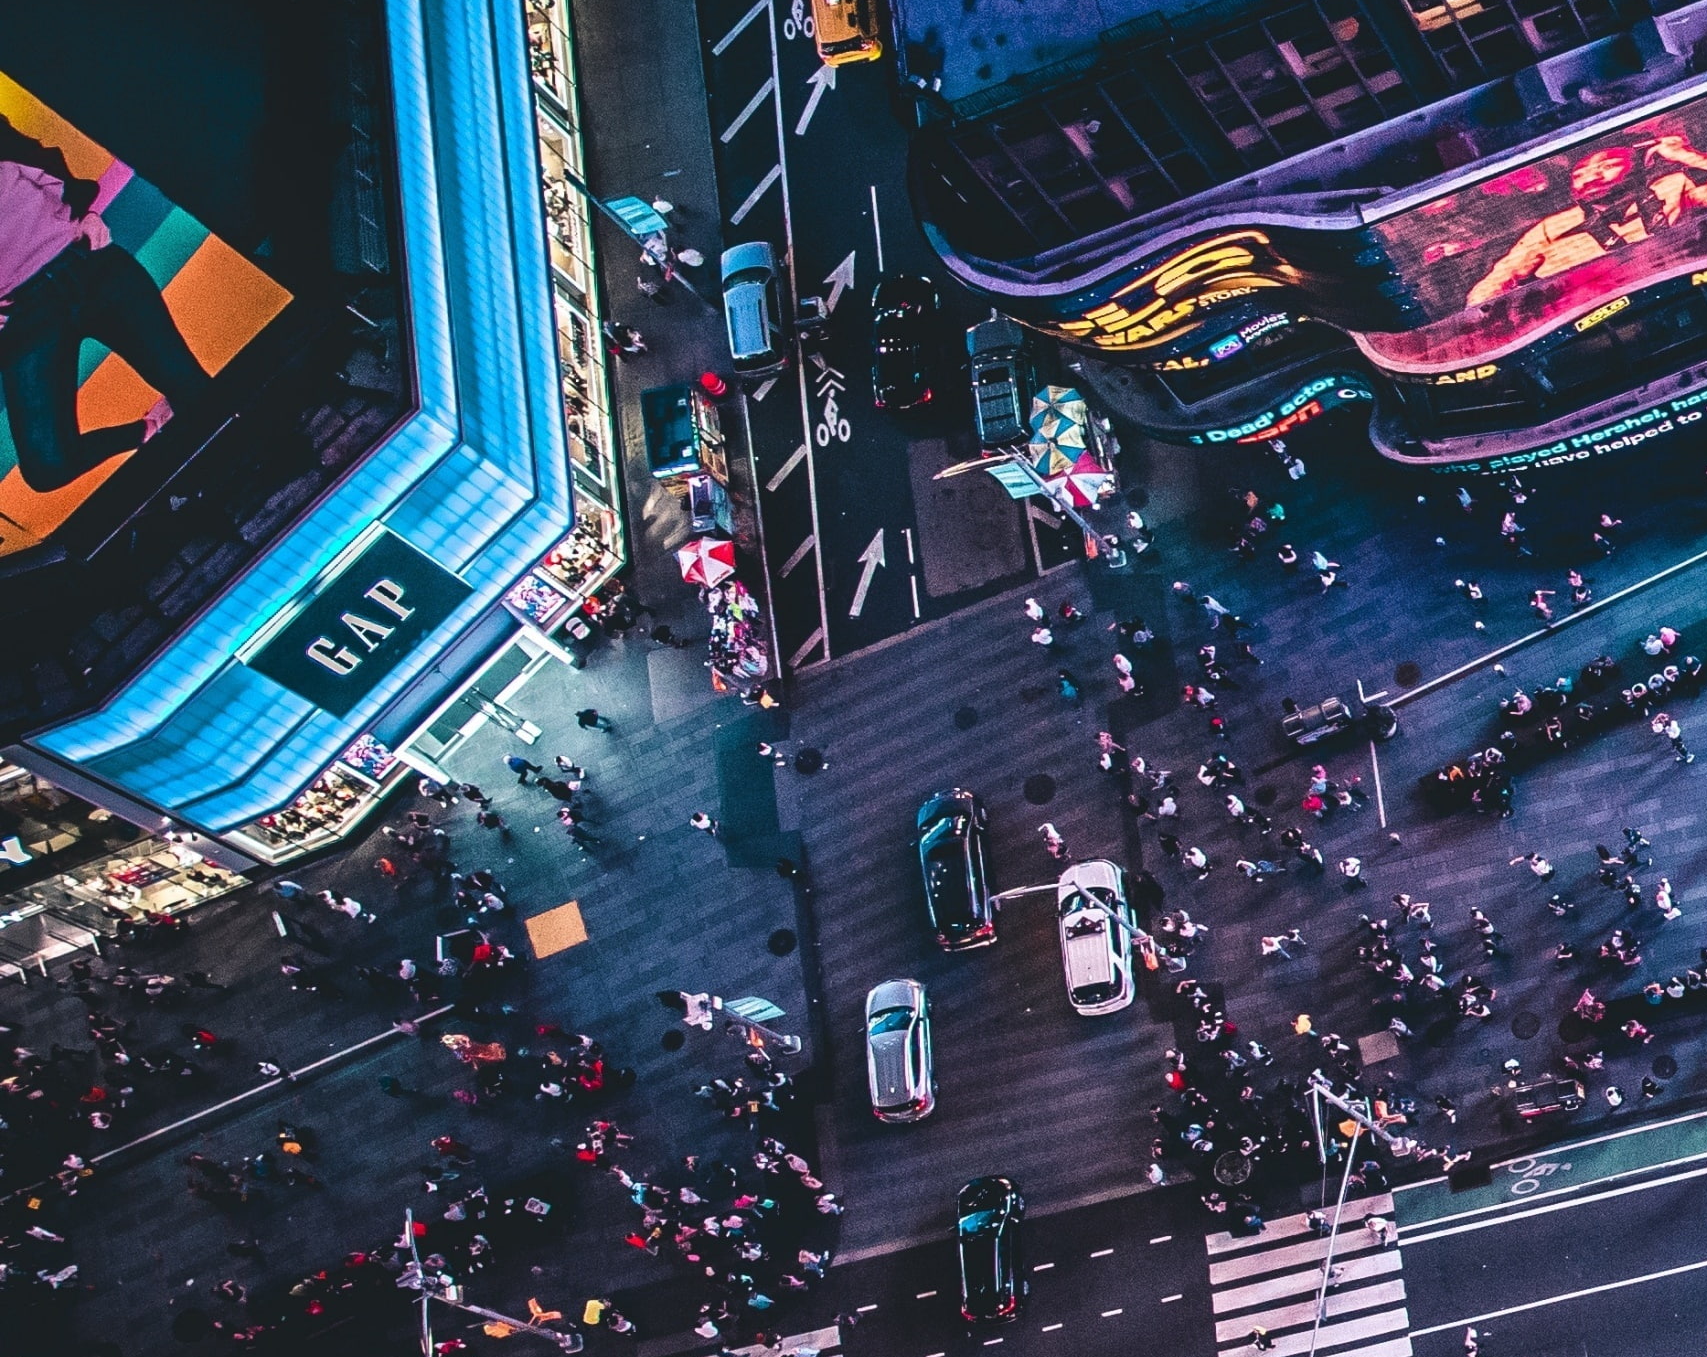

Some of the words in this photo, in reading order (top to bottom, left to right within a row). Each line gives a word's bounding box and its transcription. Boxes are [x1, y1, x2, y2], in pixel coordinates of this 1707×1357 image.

[1094, 298, 1198, 345] WARS
[1281, 377, 1336, 416] actor
[1594, 420, 1675, 456] helped
[1677, 409, 1703, 425] to
[1489, 443, 1568, 470] played
[304, 575, 417, 679] GAP
